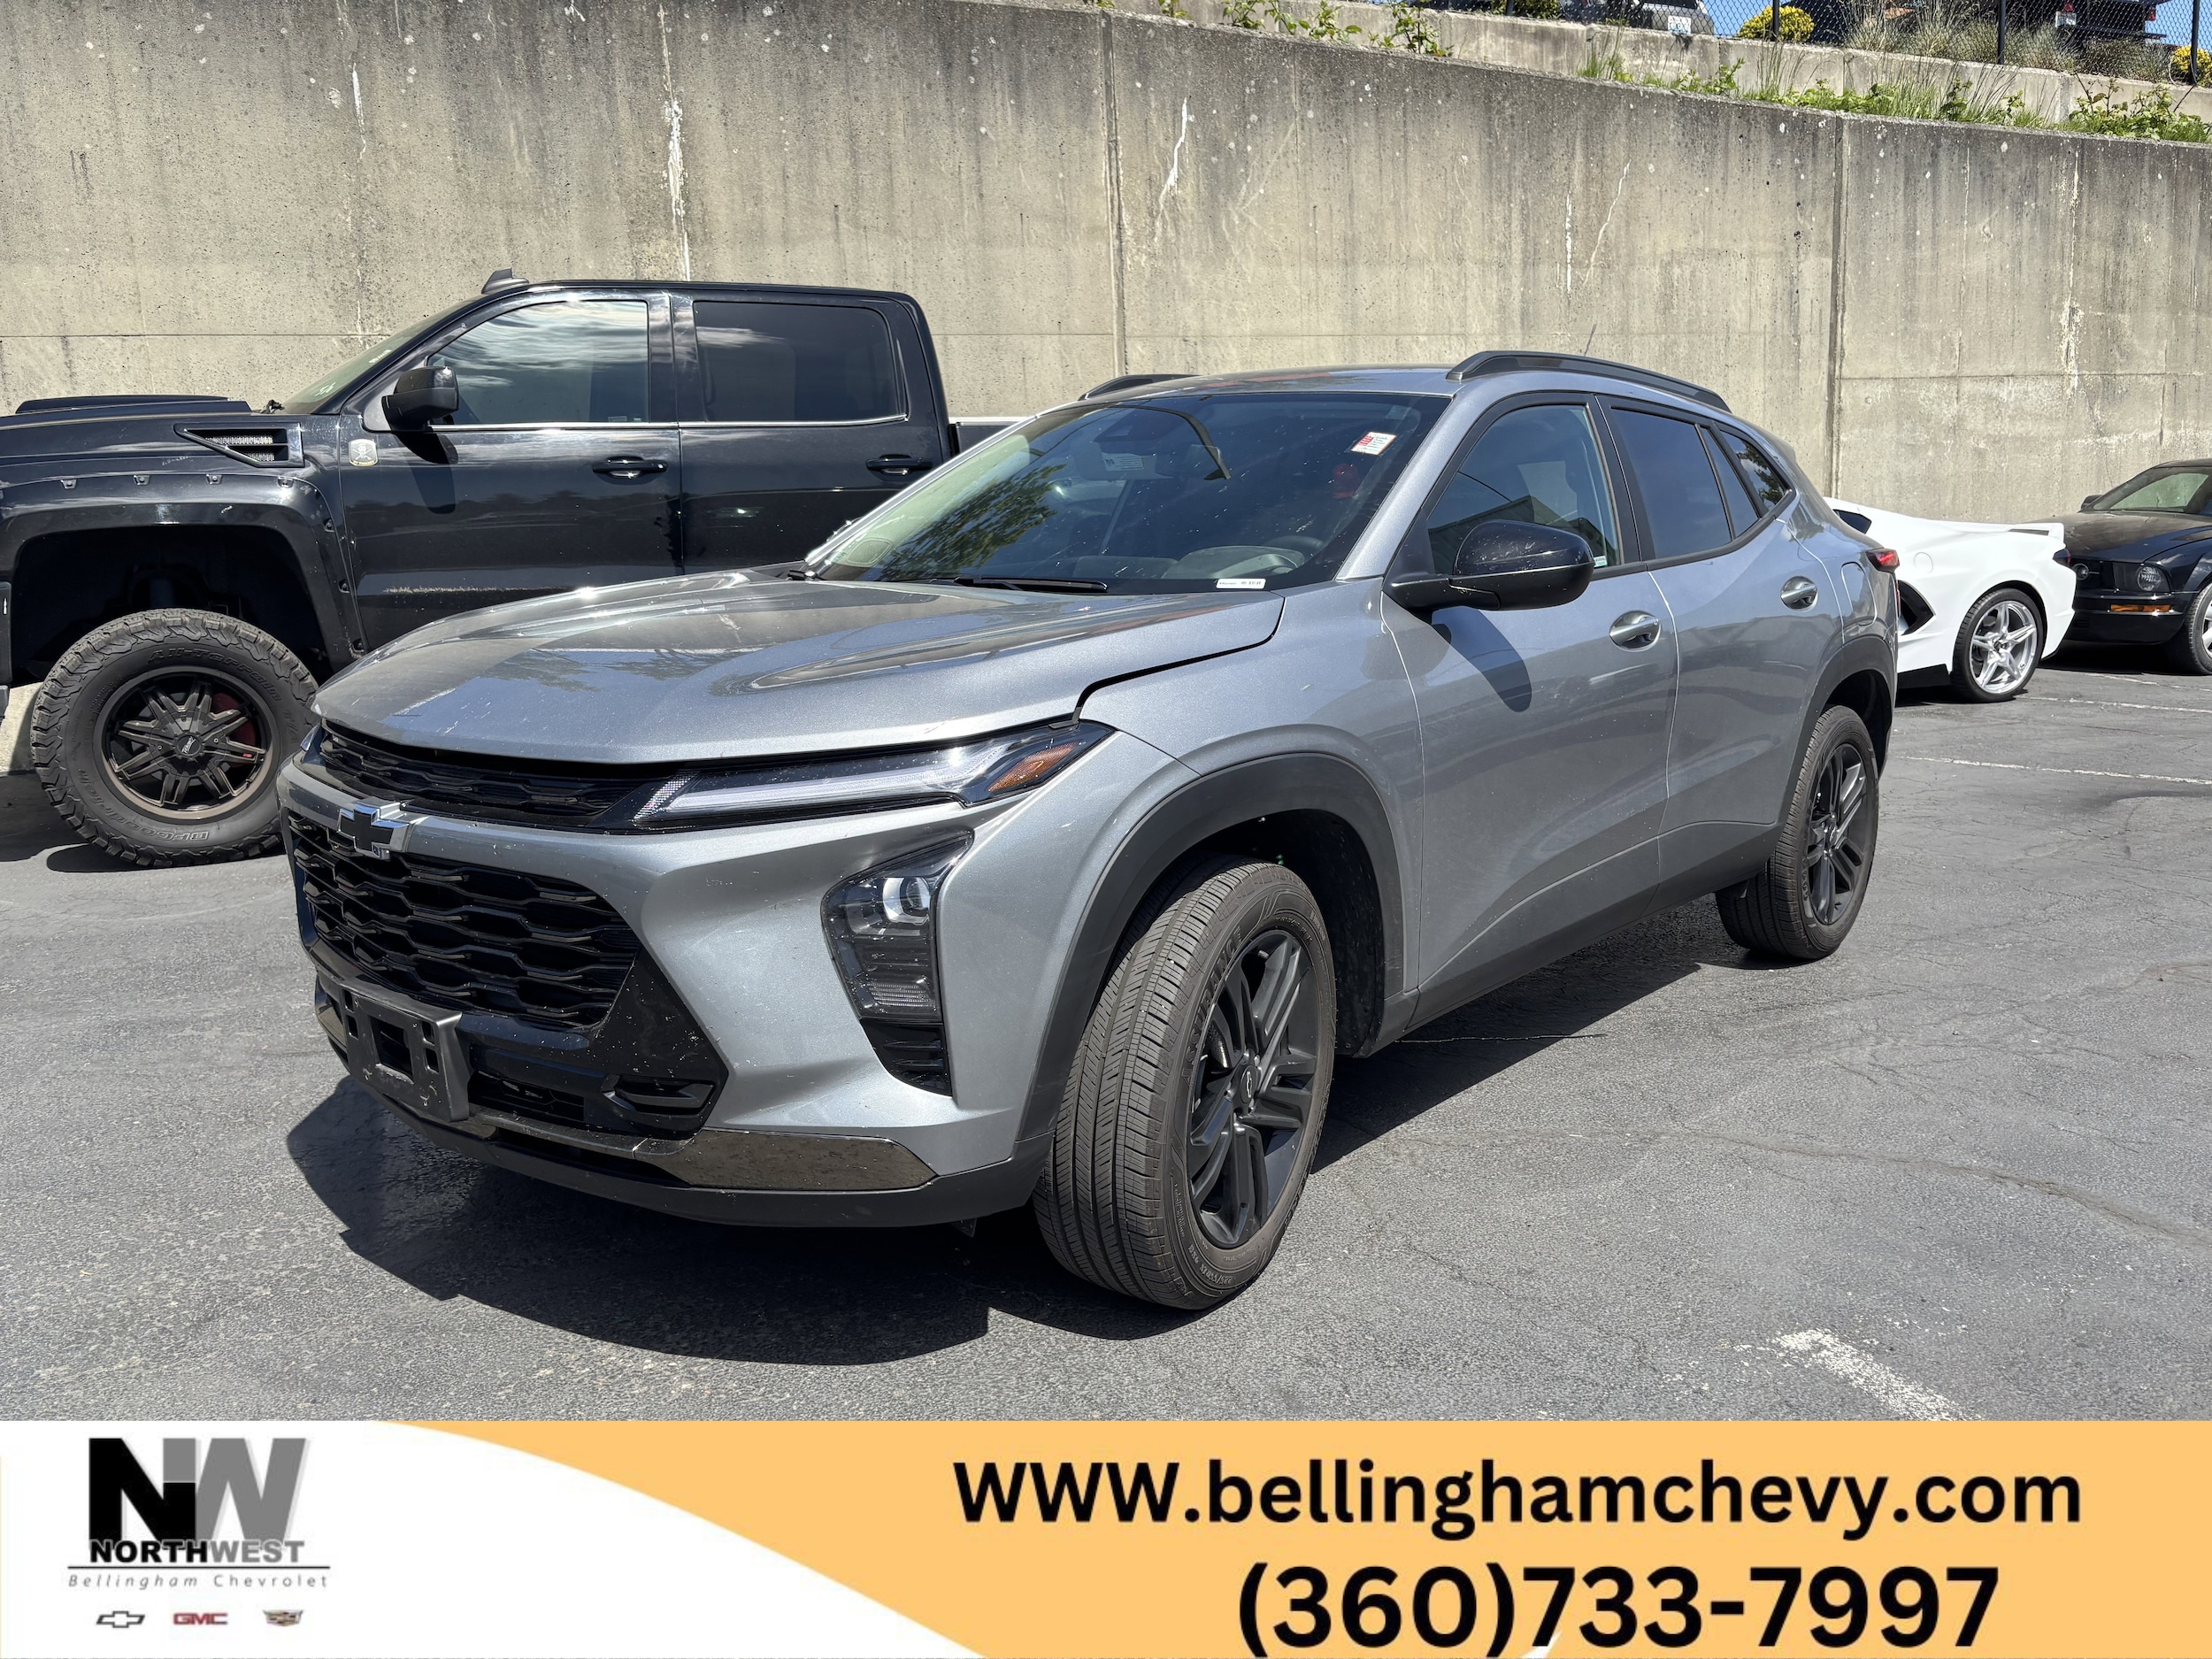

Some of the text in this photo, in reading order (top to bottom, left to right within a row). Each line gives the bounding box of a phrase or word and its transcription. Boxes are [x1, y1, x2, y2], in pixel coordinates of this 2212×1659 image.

[148, 648, 283, 702] All-Terrain
[78, 768, 210, 841] BFGoodrich
[1180, 926, 1243, 1087] ASSURANCE
